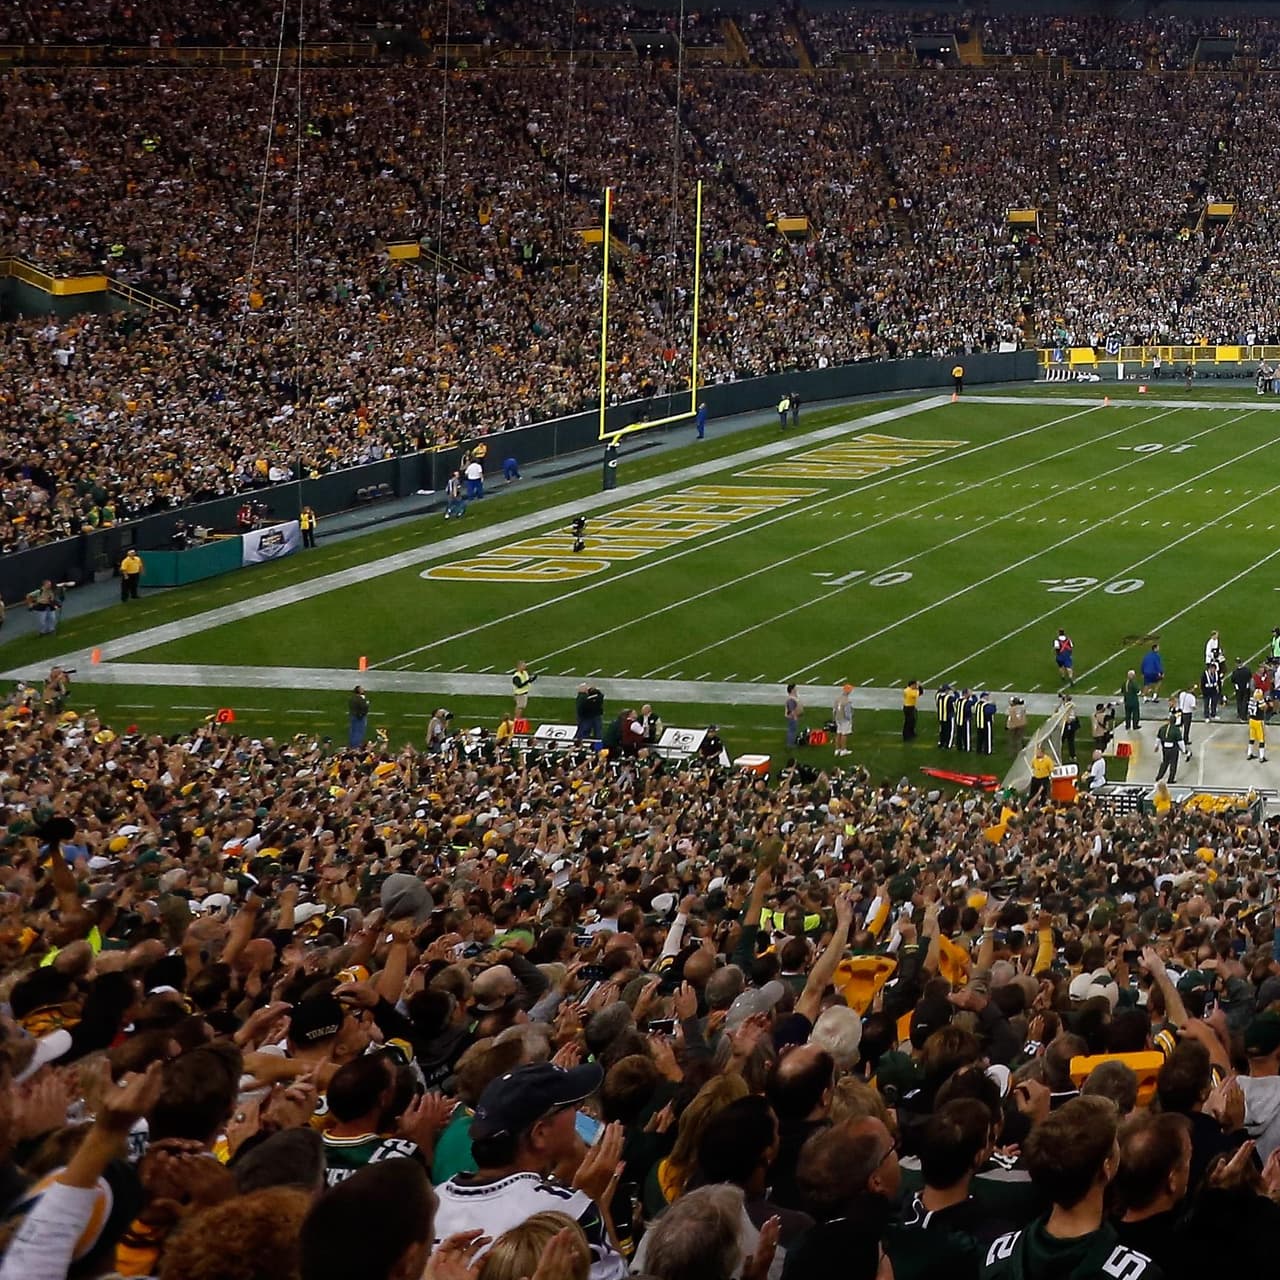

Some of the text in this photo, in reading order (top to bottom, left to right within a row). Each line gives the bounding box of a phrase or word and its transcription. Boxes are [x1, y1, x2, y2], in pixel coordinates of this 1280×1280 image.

[419, 433, 970, 583] GREEN BAY
[822, 570, 913, 588] 10
[1050, 577, 1146, 597] 20
[219, 710, 229, 720] G
[514, 720, 524, 733] 10
[810, 731, 823, 744] 20
